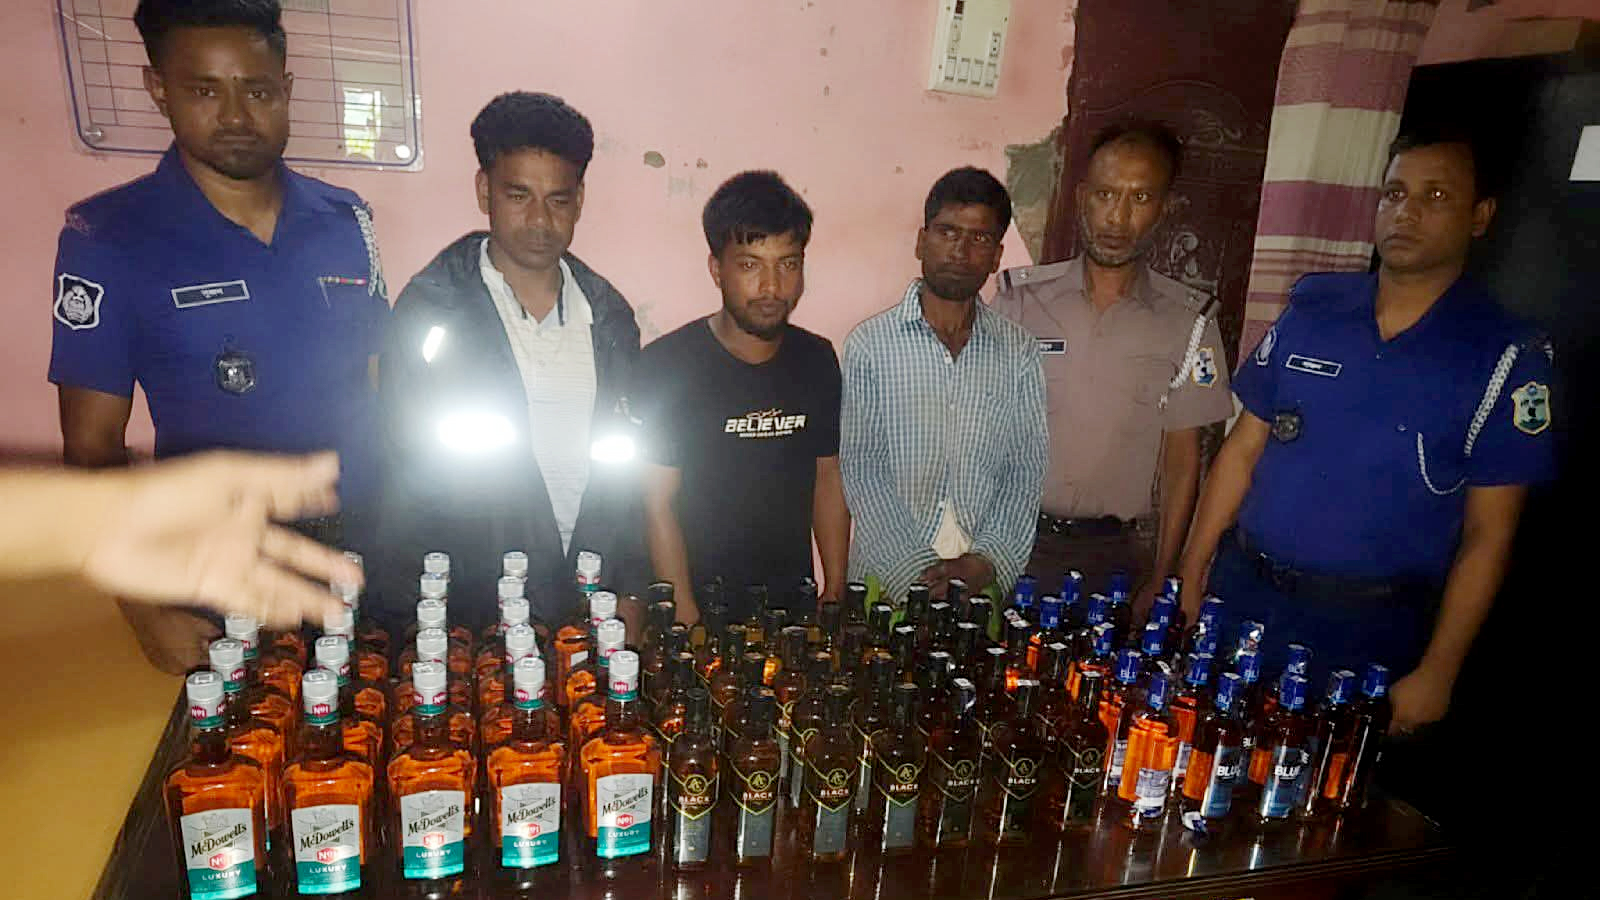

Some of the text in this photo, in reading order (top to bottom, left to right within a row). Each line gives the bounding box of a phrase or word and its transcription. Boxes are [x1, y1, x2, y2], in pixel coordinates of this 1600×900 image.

[724, 415, 806, 433] BELIEVER
[820, 788, 850, 797] BLACK
[890, 783, 919, 791] BLACK
[678, 795, 710, 803] BLACK
[743, 791, 773, 800] BLACK
[507, 796, 556, 826] McDowell's
[408, 804, 459, 836] McDowell's
[191, 823, 247, 858] McDowell's
[299, 818, 354, 852] McDowell's
[416, 849, 451, 858] LUXURY
[309, 864, 347, 874] LUXURY
[202, 869, 241, 881] LUXURY
